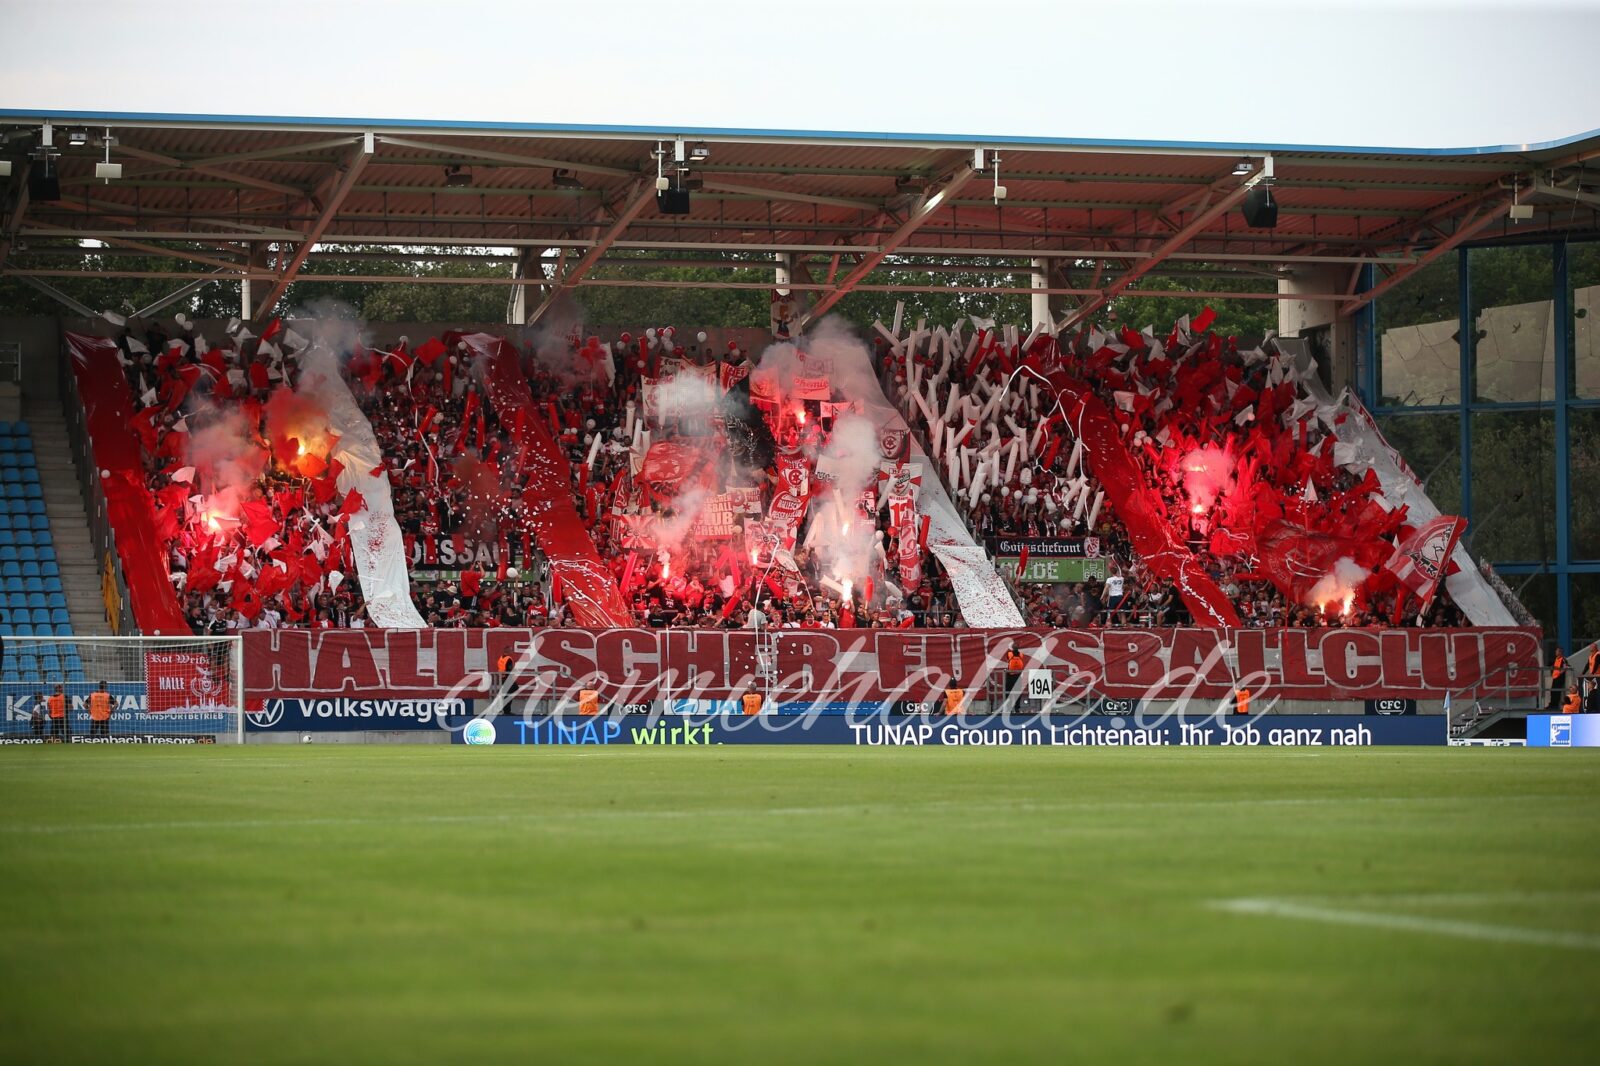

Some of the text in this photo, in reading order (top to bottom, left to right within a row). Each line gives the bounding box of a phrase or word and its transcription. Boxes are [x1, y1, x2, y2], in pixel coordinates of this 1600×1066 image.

[1000, 541, 1081, 555] Goitschefront
[151, 654, 172, 663] Rot
[242, 627, 1541, 692] HALLESCHER FUSSBALLCLUB
[159, 677, 185, 690] HALLE
[1029, 679, 1051, 695] 19A
[299, 698, 466, 722] Volkswagen
[626, 704, 648, 714] CFC
[905, 702, 929, 712] CFC
[1105, 701, 1128, 711] CFC
[1379, 700, 1402, 710] CFC
[513, 720, 621, 744] TUNAP
[849, 723, 1372, 745] TUNAP Group in Lichtenau: Ihr Job ganz nah
[0, 736, 44, 744] resore
